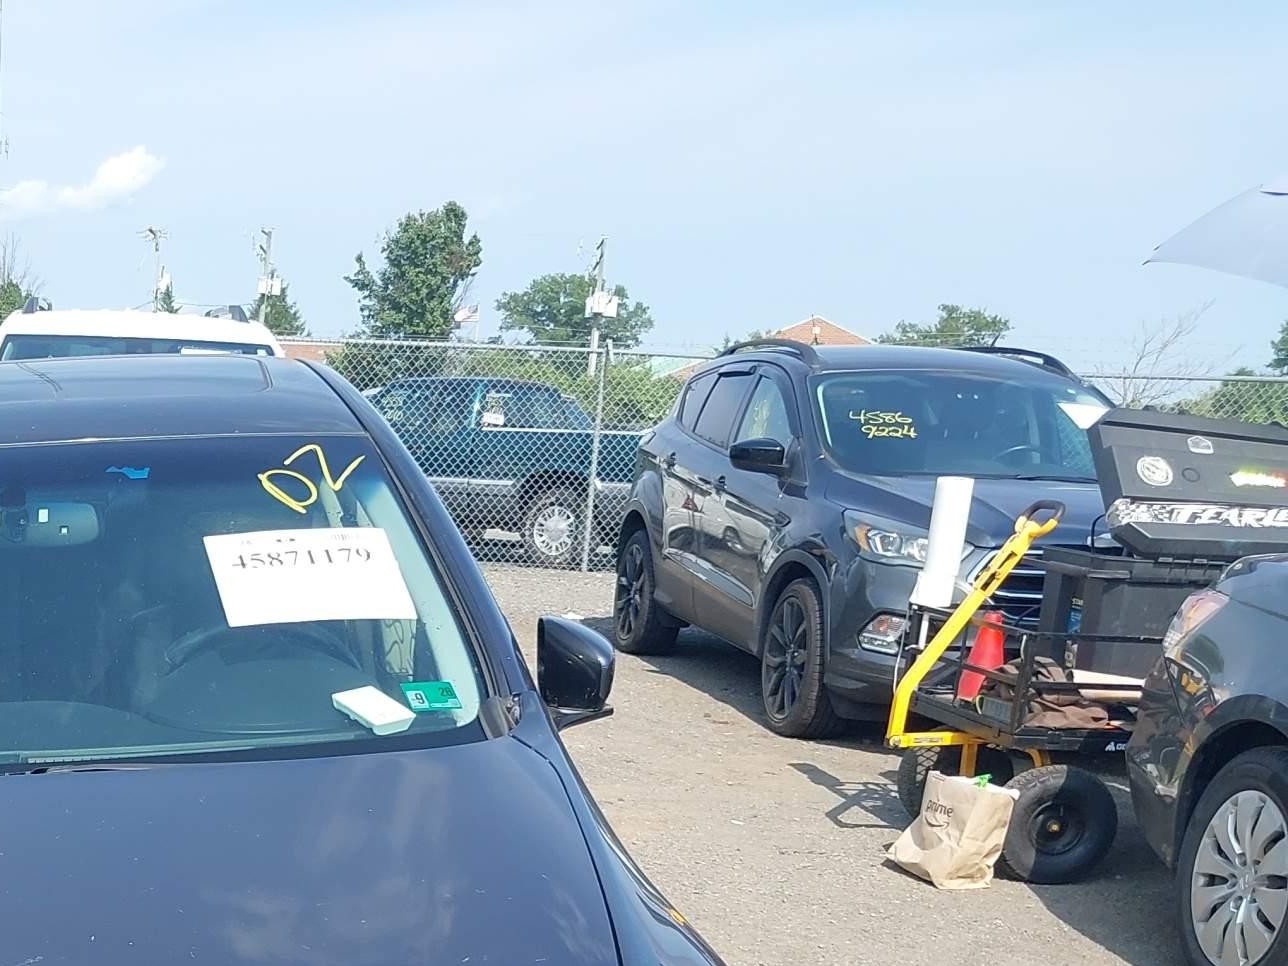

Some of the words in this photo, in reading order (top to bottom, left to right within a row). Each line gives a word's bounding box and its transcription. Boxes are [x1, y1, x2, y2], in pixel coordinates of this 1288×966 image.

[849, 409, 913, 424] 4586
[861, 424, 918, 438] 9224
[232, 548, 371, 569] 45871179
[925, 799, 954, 818] prime
